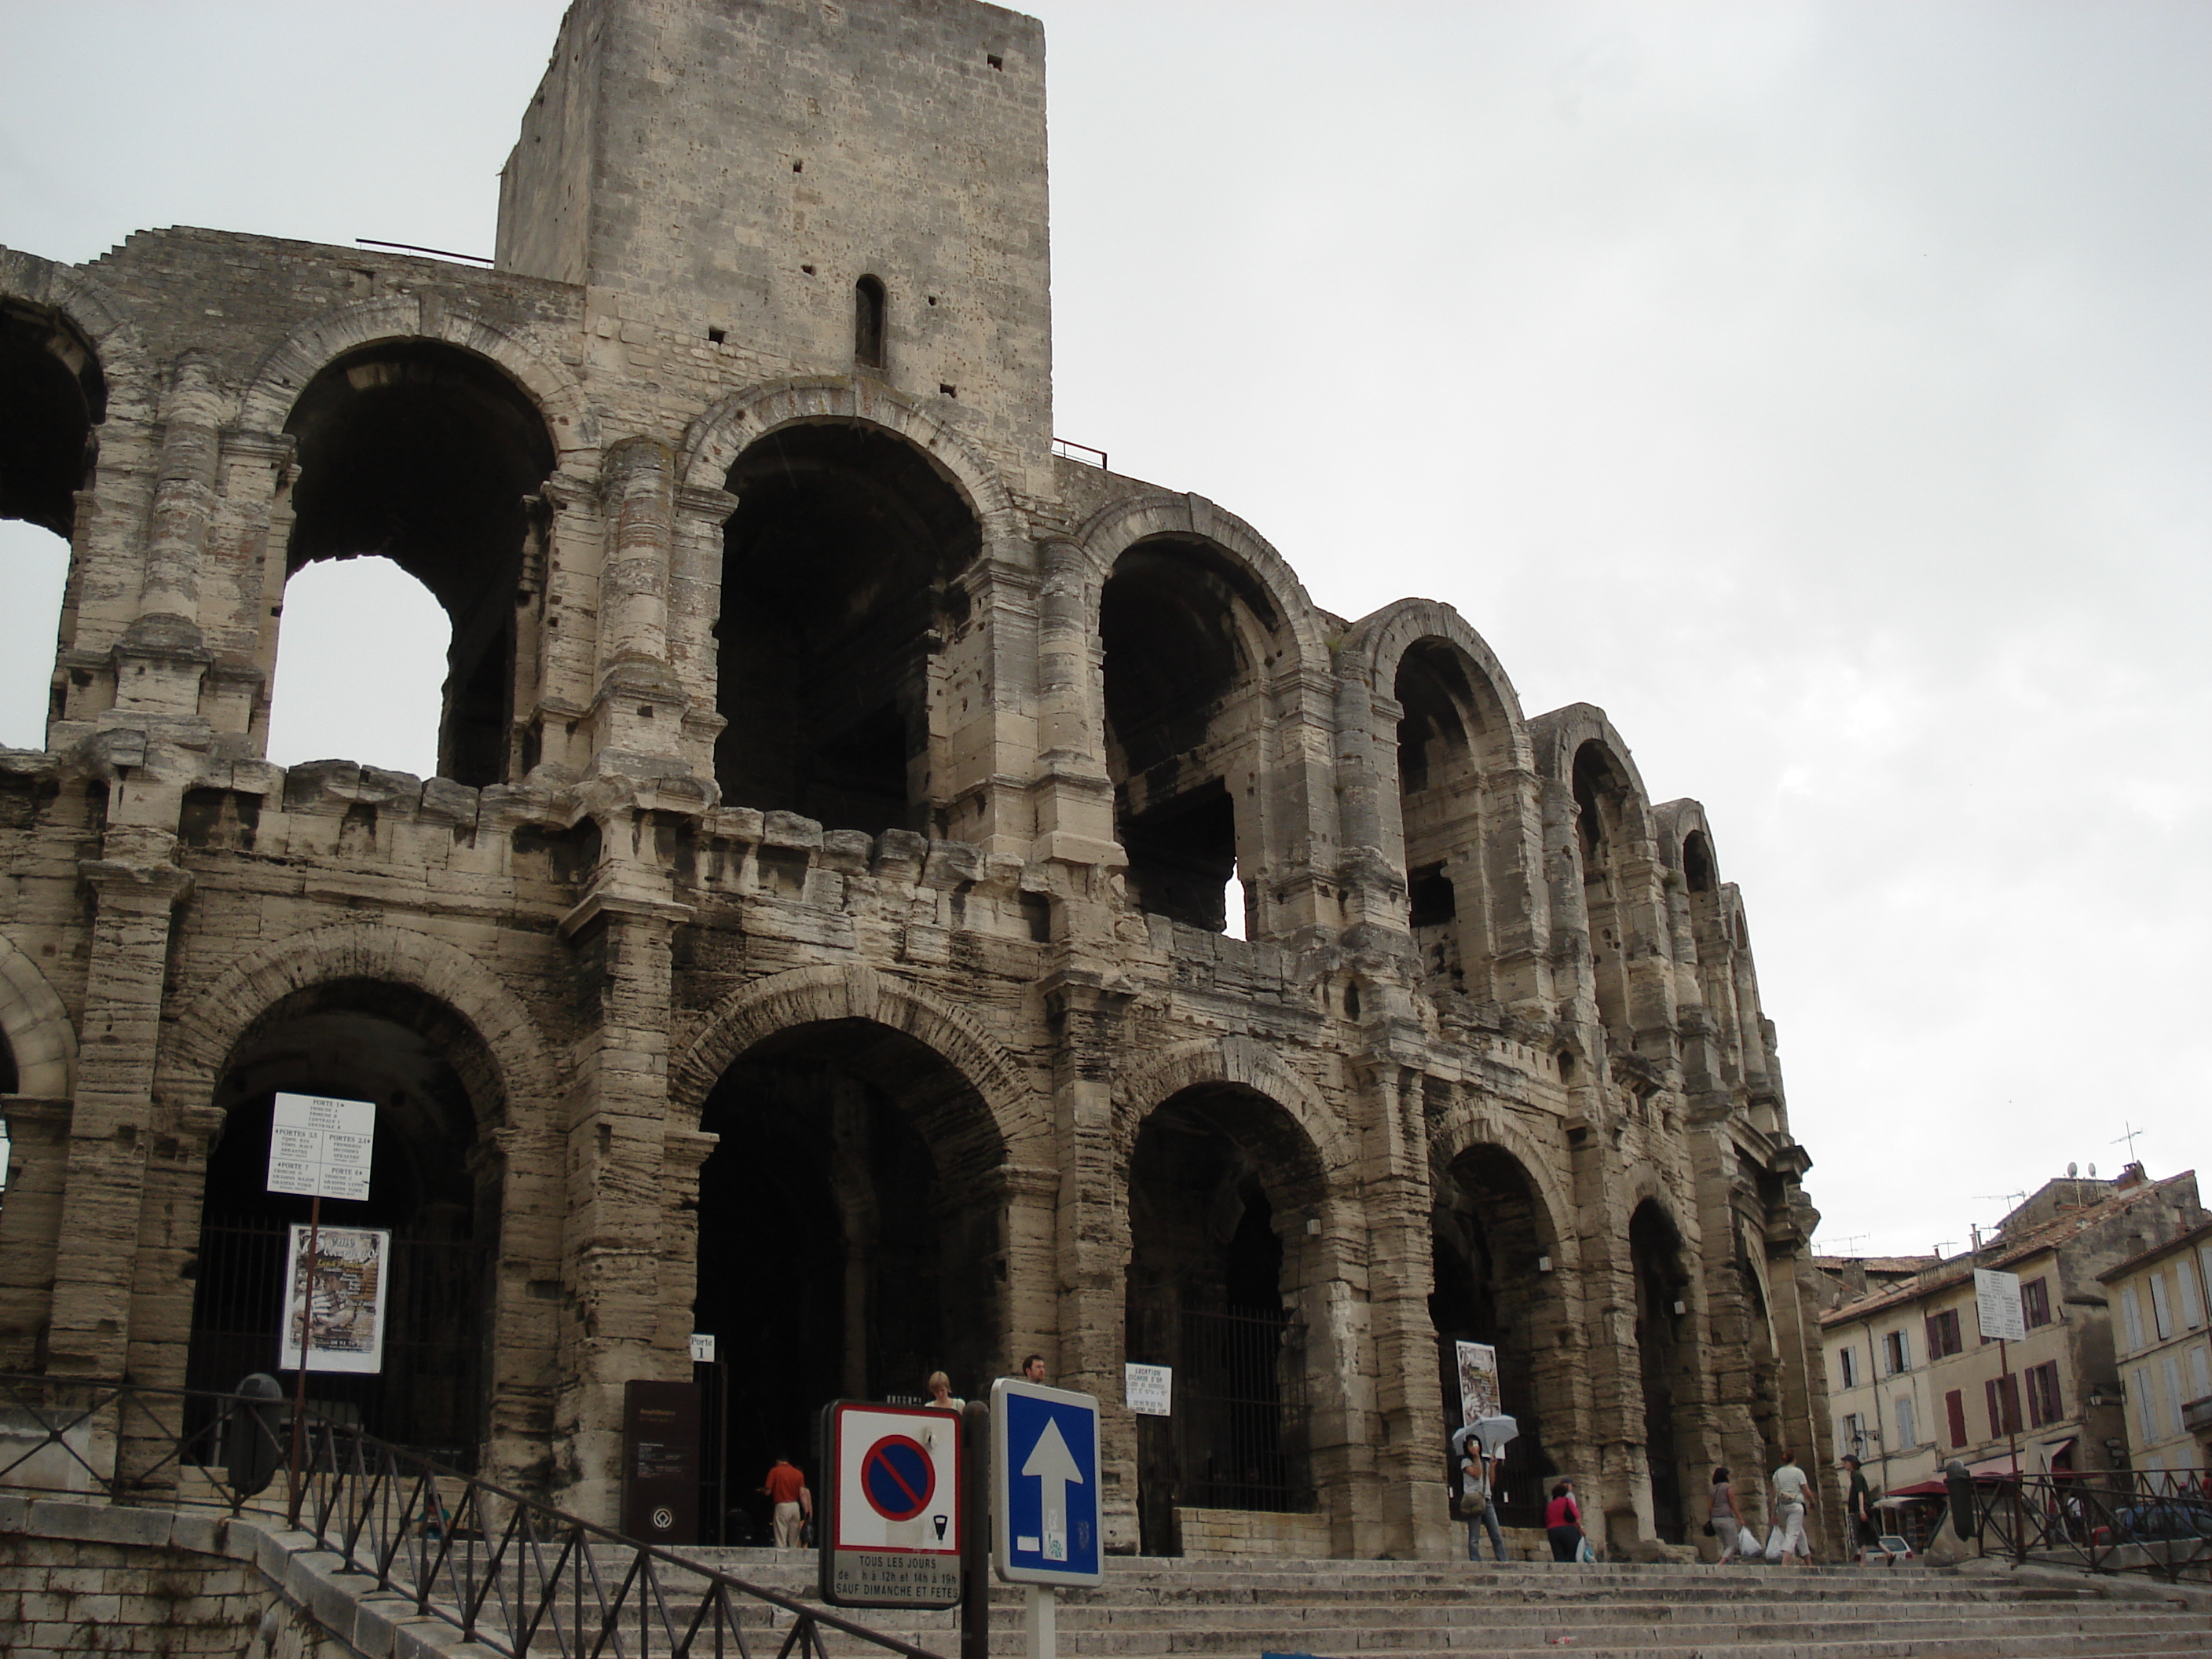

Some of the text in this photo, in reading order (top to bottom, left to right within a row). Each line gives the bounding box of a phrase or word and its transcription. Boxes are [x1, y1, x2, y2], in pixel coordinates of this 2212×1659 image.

[329, 1134, 355, 1143] PORTES
[691, 1337, 712, 1346] Porte
[698, 1347, 705, 1359] 1
[1136, 1368, 1161, 1376] LOCATION
[859, 1556, 936, 1569] TOUS LES JOURS
[838, 1570, 848, 1580] de
[872, 1571, 876, 1581] à
[882, 1571, 895, 1581] 12h
[900, 1573, 908, 1582] et
[914, 1573, 928, 1583] 14h
[932, 1573, 936, 1584] à
[943, 1573, 956, 1584] 19h
[836, 1583, 958, 1599] SAUF DIMANCHE ET FETES
